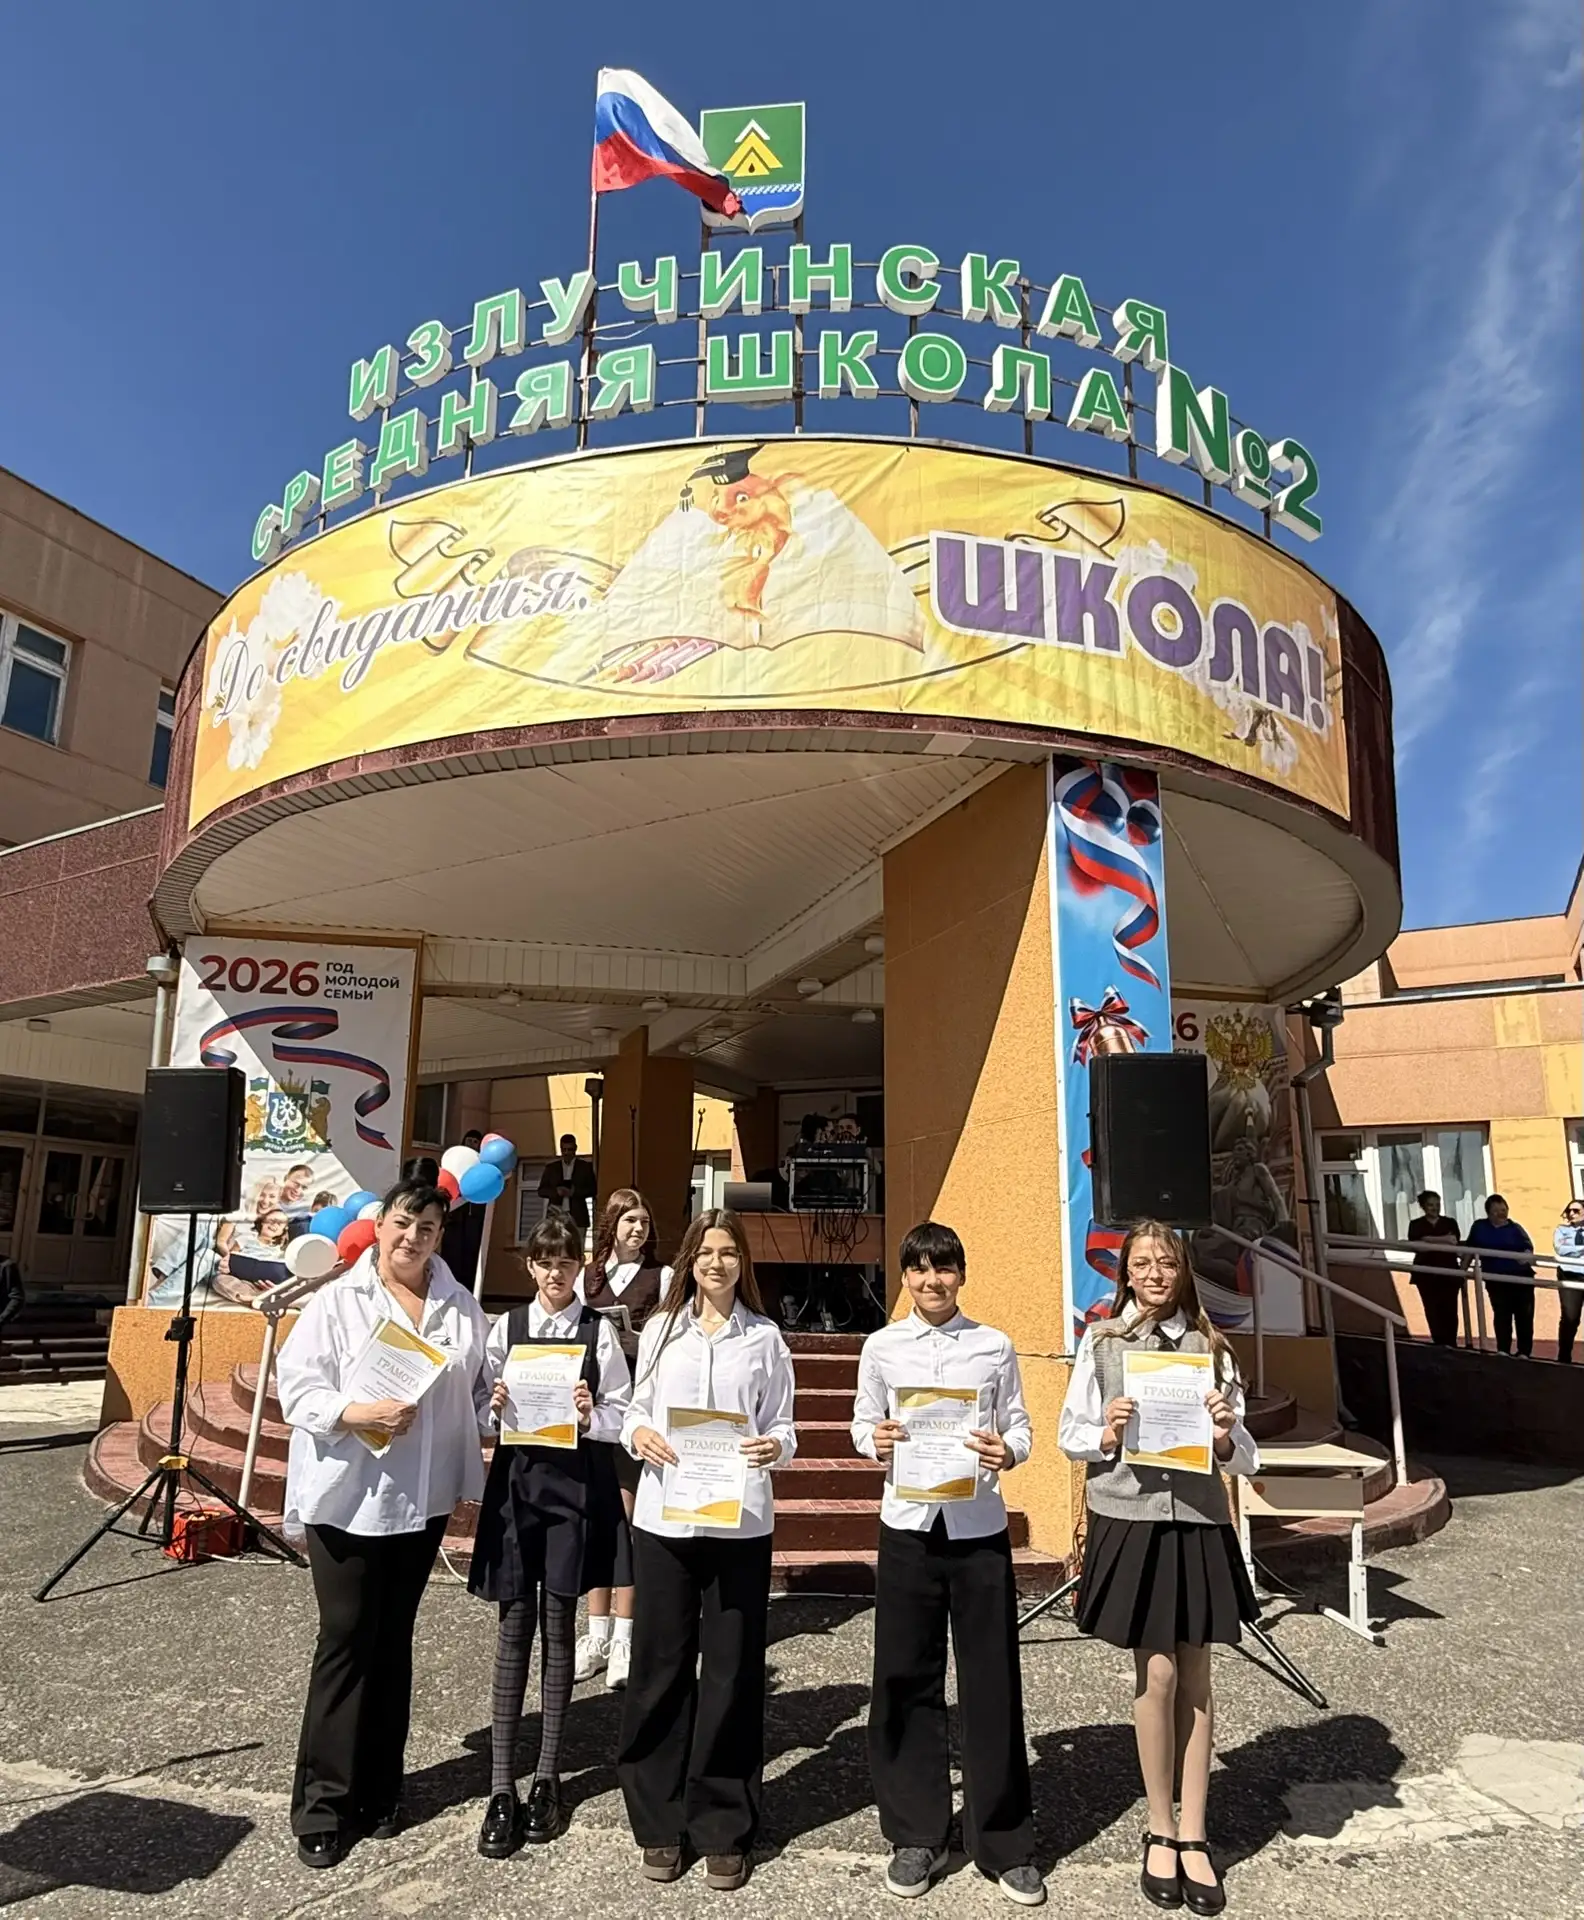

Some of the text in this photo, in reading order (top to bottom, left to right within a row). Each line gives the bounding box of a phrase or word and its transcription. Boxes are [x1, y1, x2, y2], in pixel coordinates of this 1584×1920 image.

[349, 243, 1168, 420] ИЗЛУЧИНСКАЯ
[251, 344, 656, 561] СРЕДНЯЯ
[707, 330, 1131, 441] ШКОЛА
[934, 535, 1327, 731] ШКОЛА!
[212, 638, 264, 726] До
[198, 955, 320, 997] 2026
[326, 962, 354, 974] ГОД
[324, 988, 373, 1000] СЕМЬИ
[325, 975, 400, 989] МОЛОДОЙ
[377, 1356, 419, 1390] ГРАМОТА
[519, 1371, 567, 1382] ГРАМОТА
[1144, 1386, 1200, 1400] ГРАМОТА
[683, 1439, 735, 1452] ГРАМОТА
